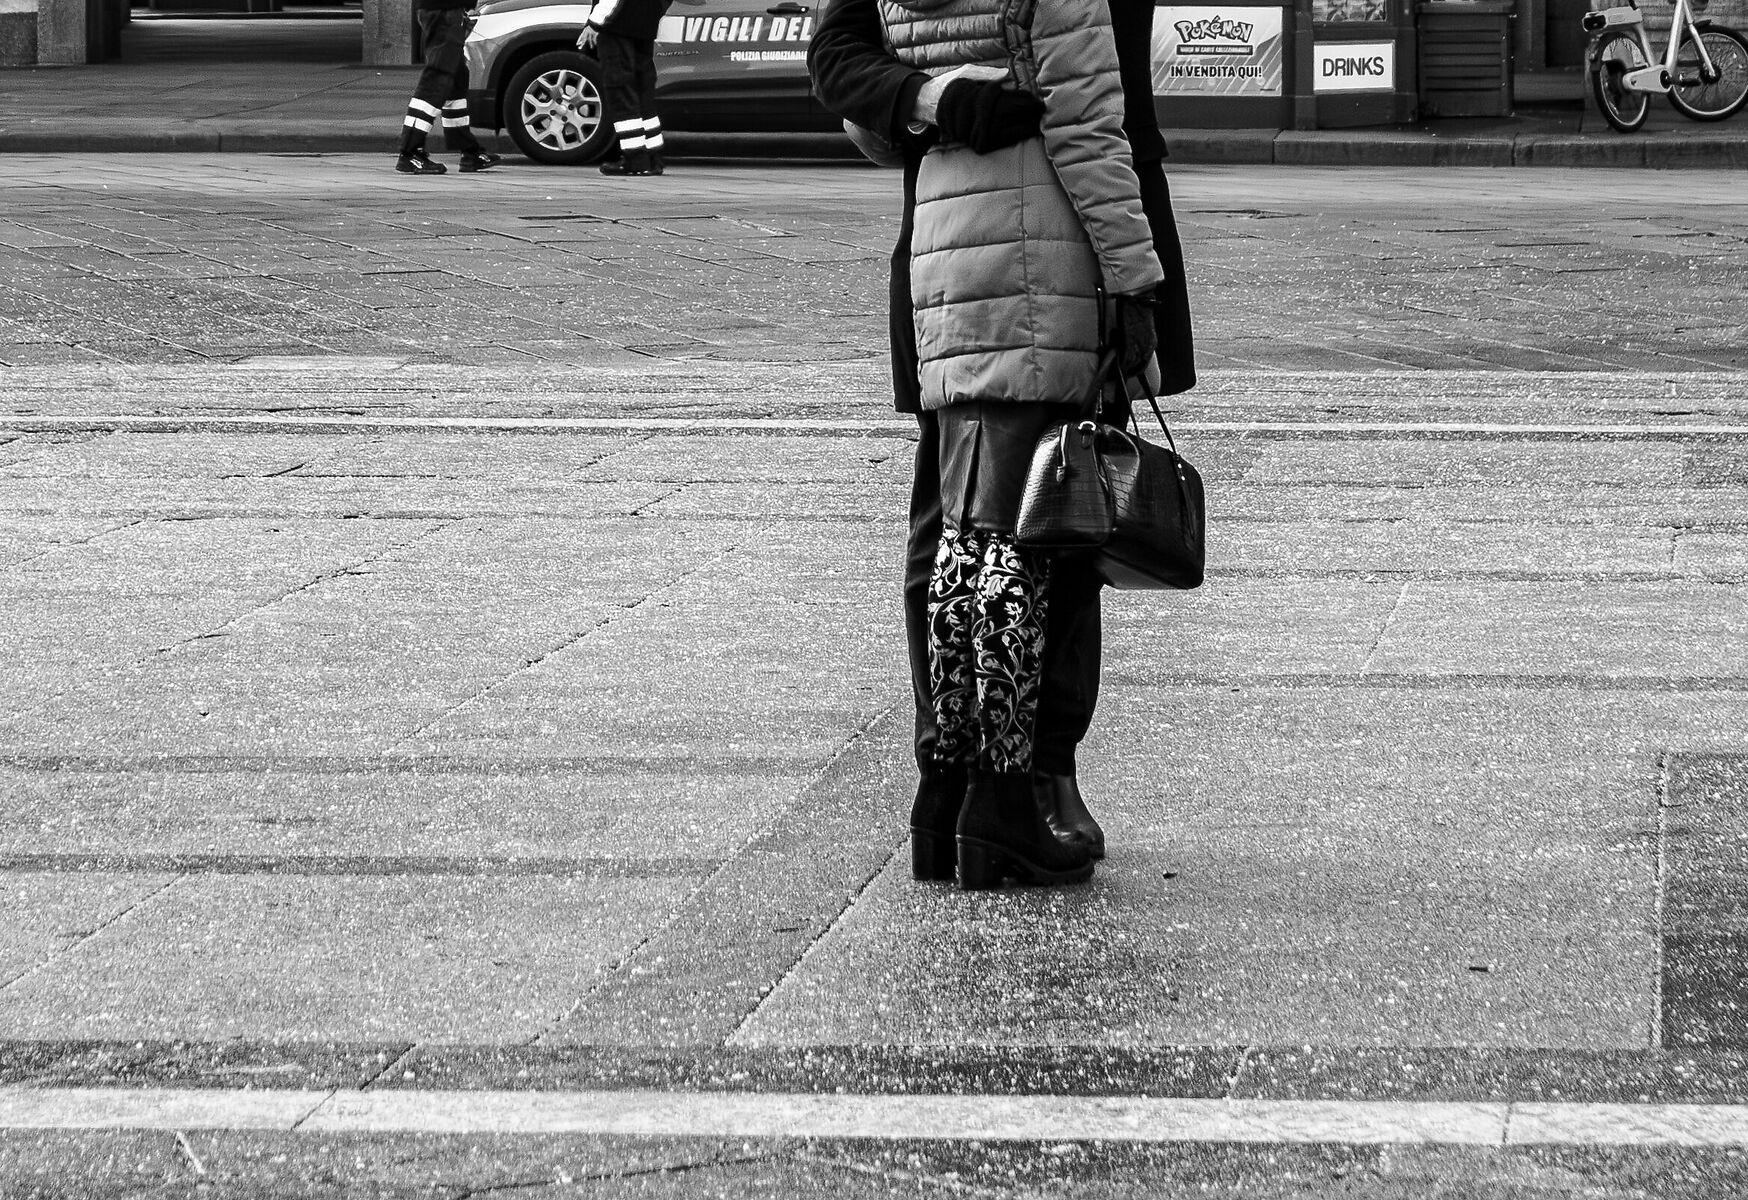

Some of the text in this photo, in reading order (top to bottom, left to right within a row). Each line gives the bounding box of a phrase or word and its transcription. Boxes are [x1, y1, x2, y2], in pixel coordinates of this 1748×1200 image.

[685, 17, 812, 42] VIGILI DEL
[731, 52, 760, 62] POLIZIA
[1171, 66, 1262, 79] IN VENDITA QUI!
[1322, 56, 1384, 77] DRINKS
